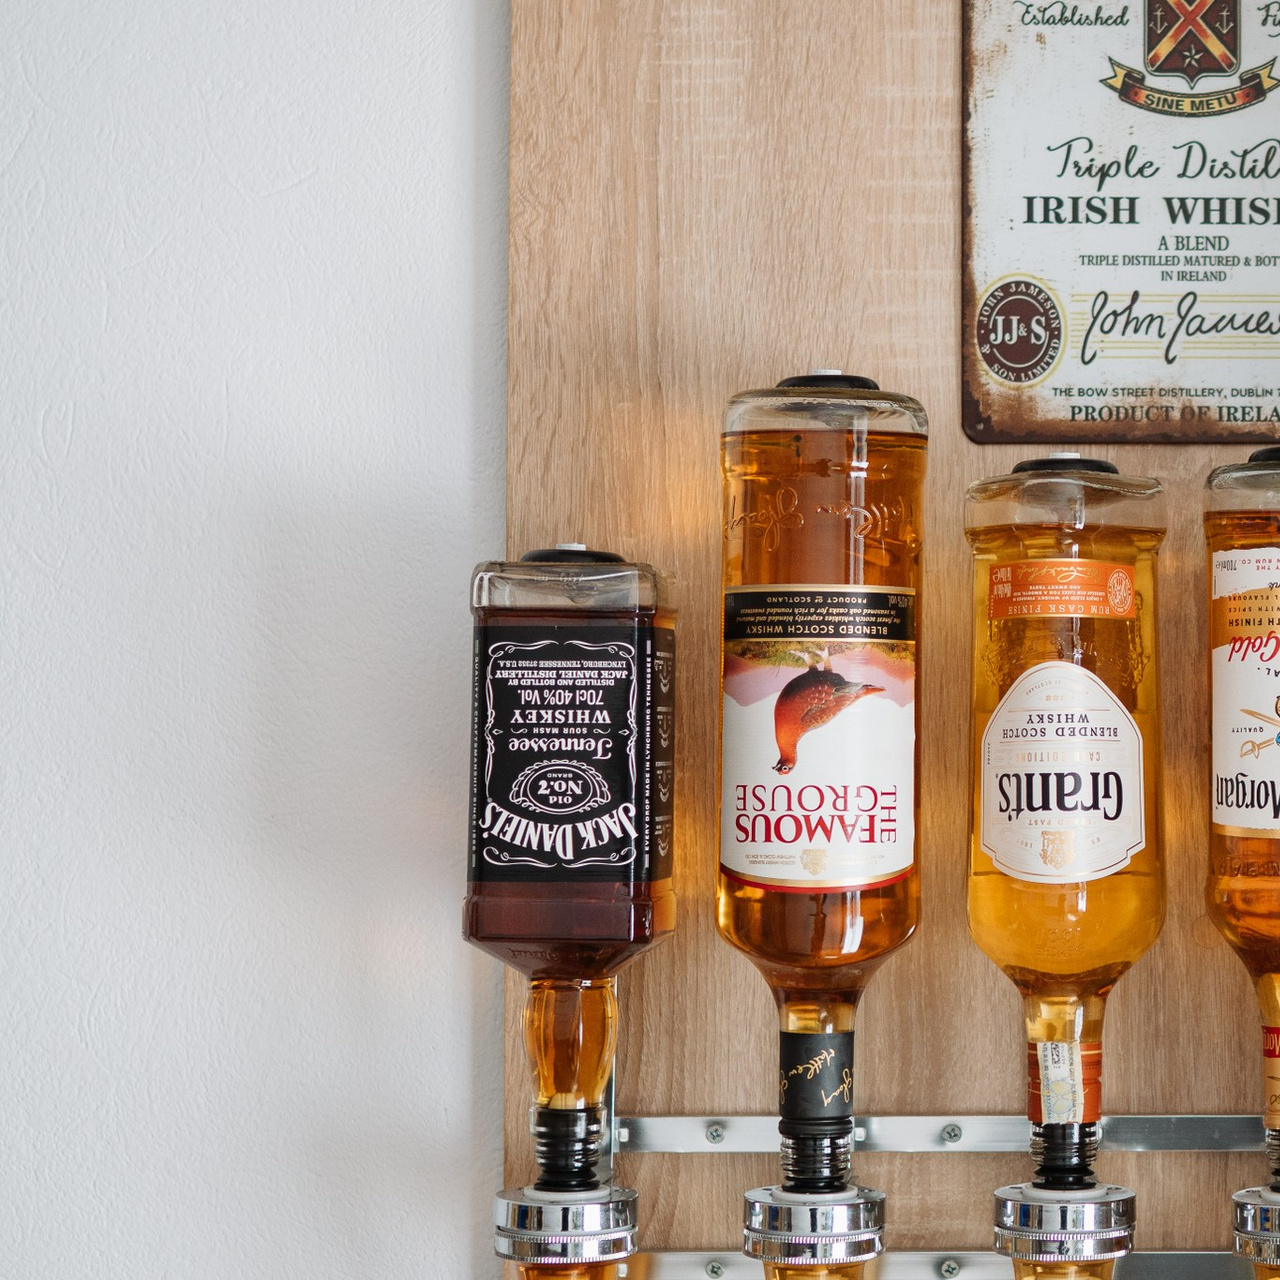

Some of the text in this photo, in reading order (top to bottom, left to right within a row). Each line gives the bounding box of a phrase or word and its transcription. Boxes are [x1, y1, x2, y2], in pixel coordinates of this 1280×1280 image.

[1012, 0, 1130, 27] Established
[1144, 92, 1238, 112] SINE METU
[1047, 136, 1160, 192] Triple
[1022, 196, 1140, 225] IRISH
[1158, 235, 1230, 251] A BLEND
[1080, 255, 1119, 267] TRIPLE
[1122, 255, 1180, 267] DISTILLED
[1183, 255, 1240, 267] MATURED
[1160, 271, 1227, 282] IN IRELAND
[1053, 387, 1272, 398] THE BOW STREET DUBLIN
[1070, 406, 1174, 423] PRODUCT
[1180, 406, 1211, 423] OF
[1008, 604, 1110, 614] RUM CASK FINISH
[788, 625, 834, 633] SCOTCH
[839, 626, 888, 634] BLENDED
[1228, 618, 1262, 626] FINISH
[1228, 630, 1280, 662] Gold
[495, 670, 628, 678] JACK DANIEL DISTILLERY
[544, 690, 573, 704] 40%
[510, 710, 611, 724] WHISKEY
[1027, 714, 1089, 724] WHISKY
[1003, 727, 1118, 738] BLENDED SCOTCH
[509, 738, 612, 759] Tennessee
[735, 785, 878, 812] GROUSE
[999, 772, 1123, 821] Grant's
[880, 785, 897, 843] THE
[575, 803, 638, 850] JACK
[735, 814, 877, 843] FAMOUS
